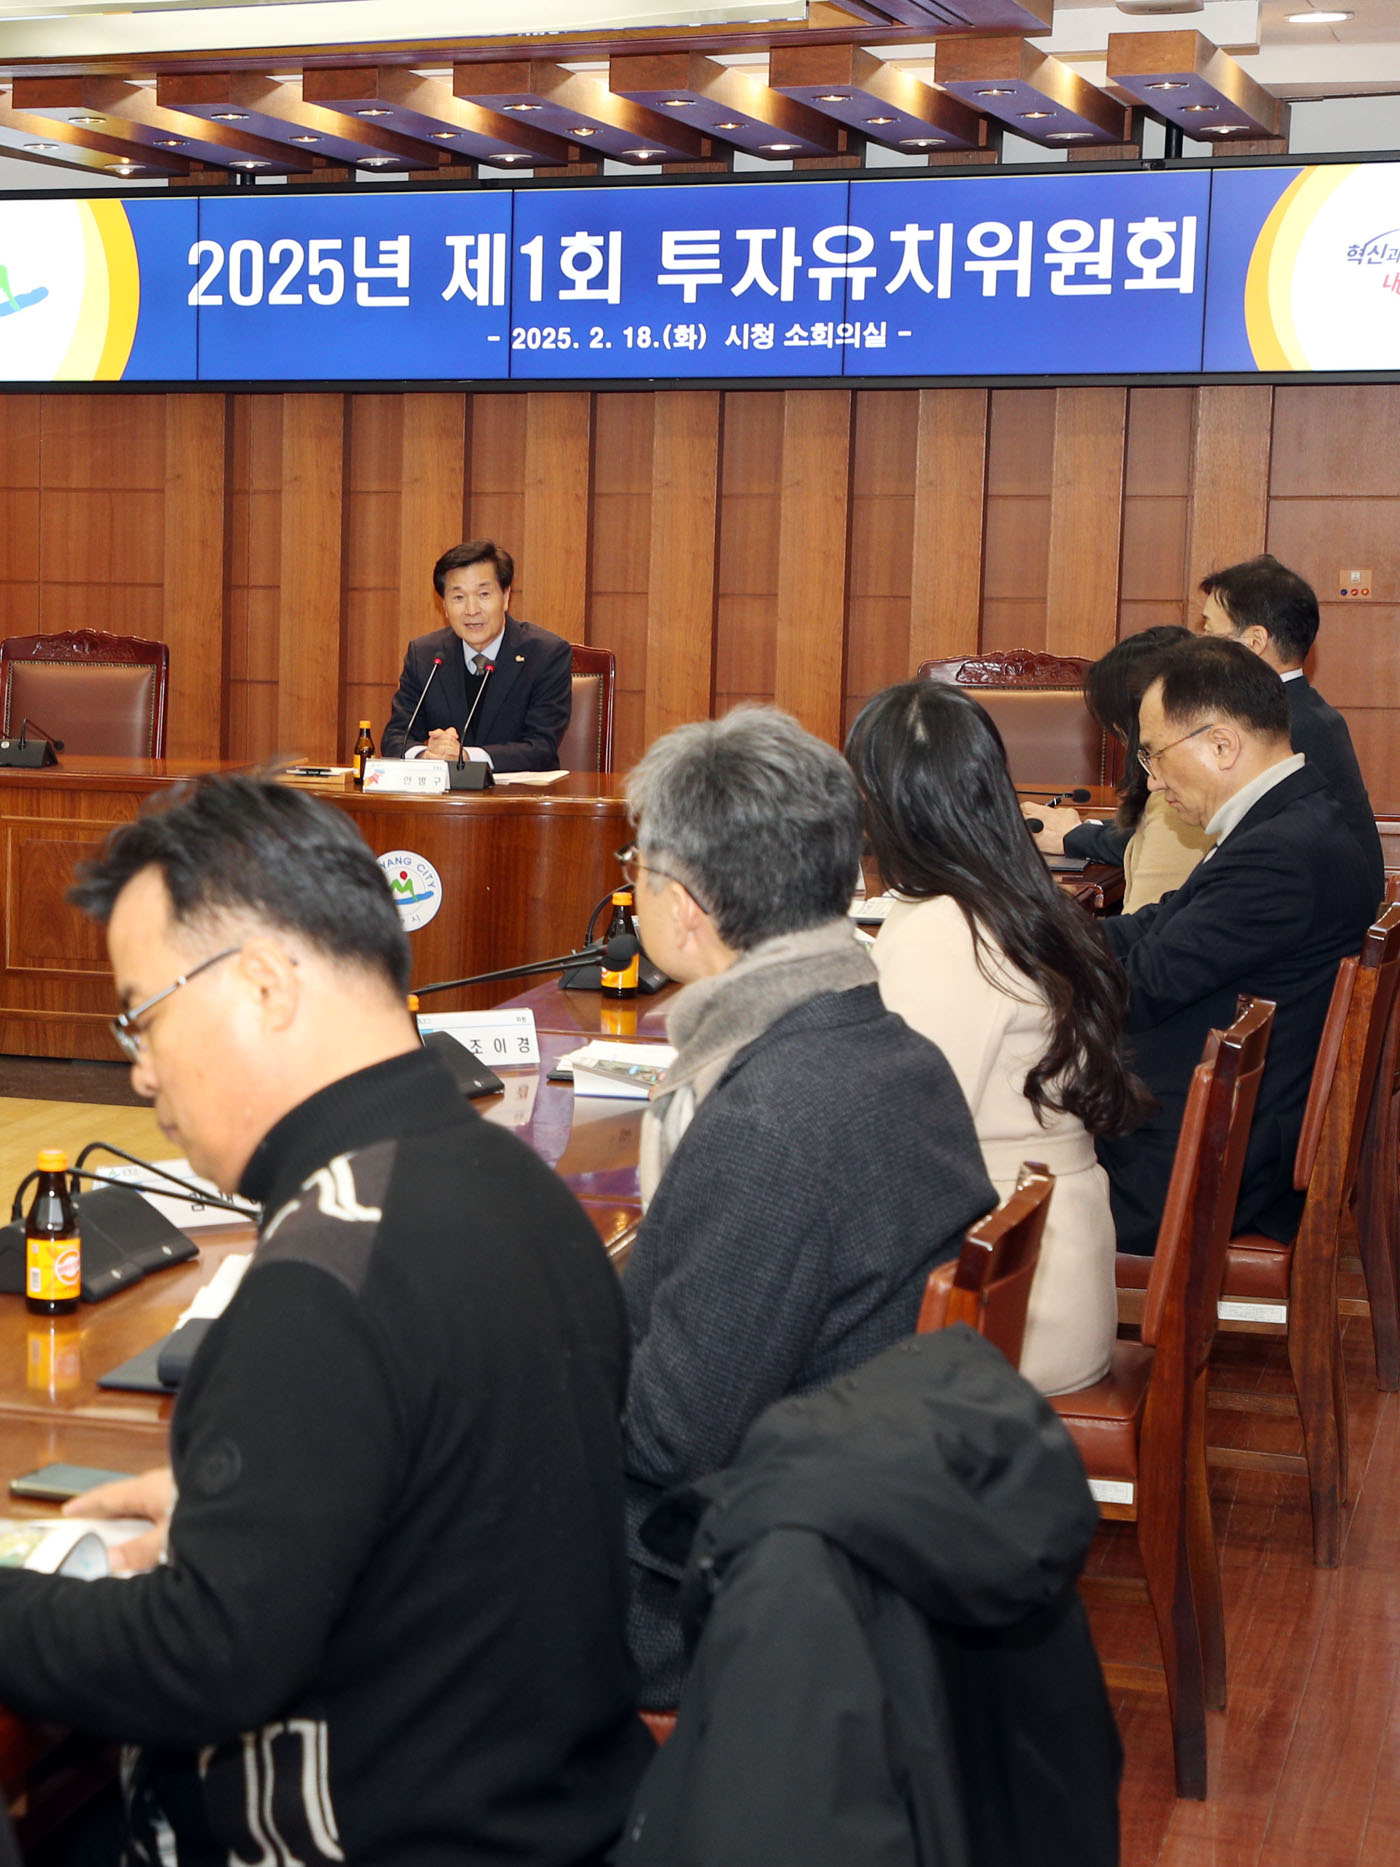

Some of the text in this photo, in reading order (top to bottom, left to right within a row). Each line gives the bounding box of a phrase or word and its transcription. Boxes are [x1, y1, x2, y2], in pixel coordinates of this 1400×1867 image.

[188, 215, 1198, 307] 2025년 제1회 투자유치위원회
[511, 326, 580, 350] 2025.
[589, 326, 612, 349] 2.
[724, 322, 775, 350] 시청
[783, 321, 887, 349] 소회의실
[380, 857, 436, 889] YANG CITY
